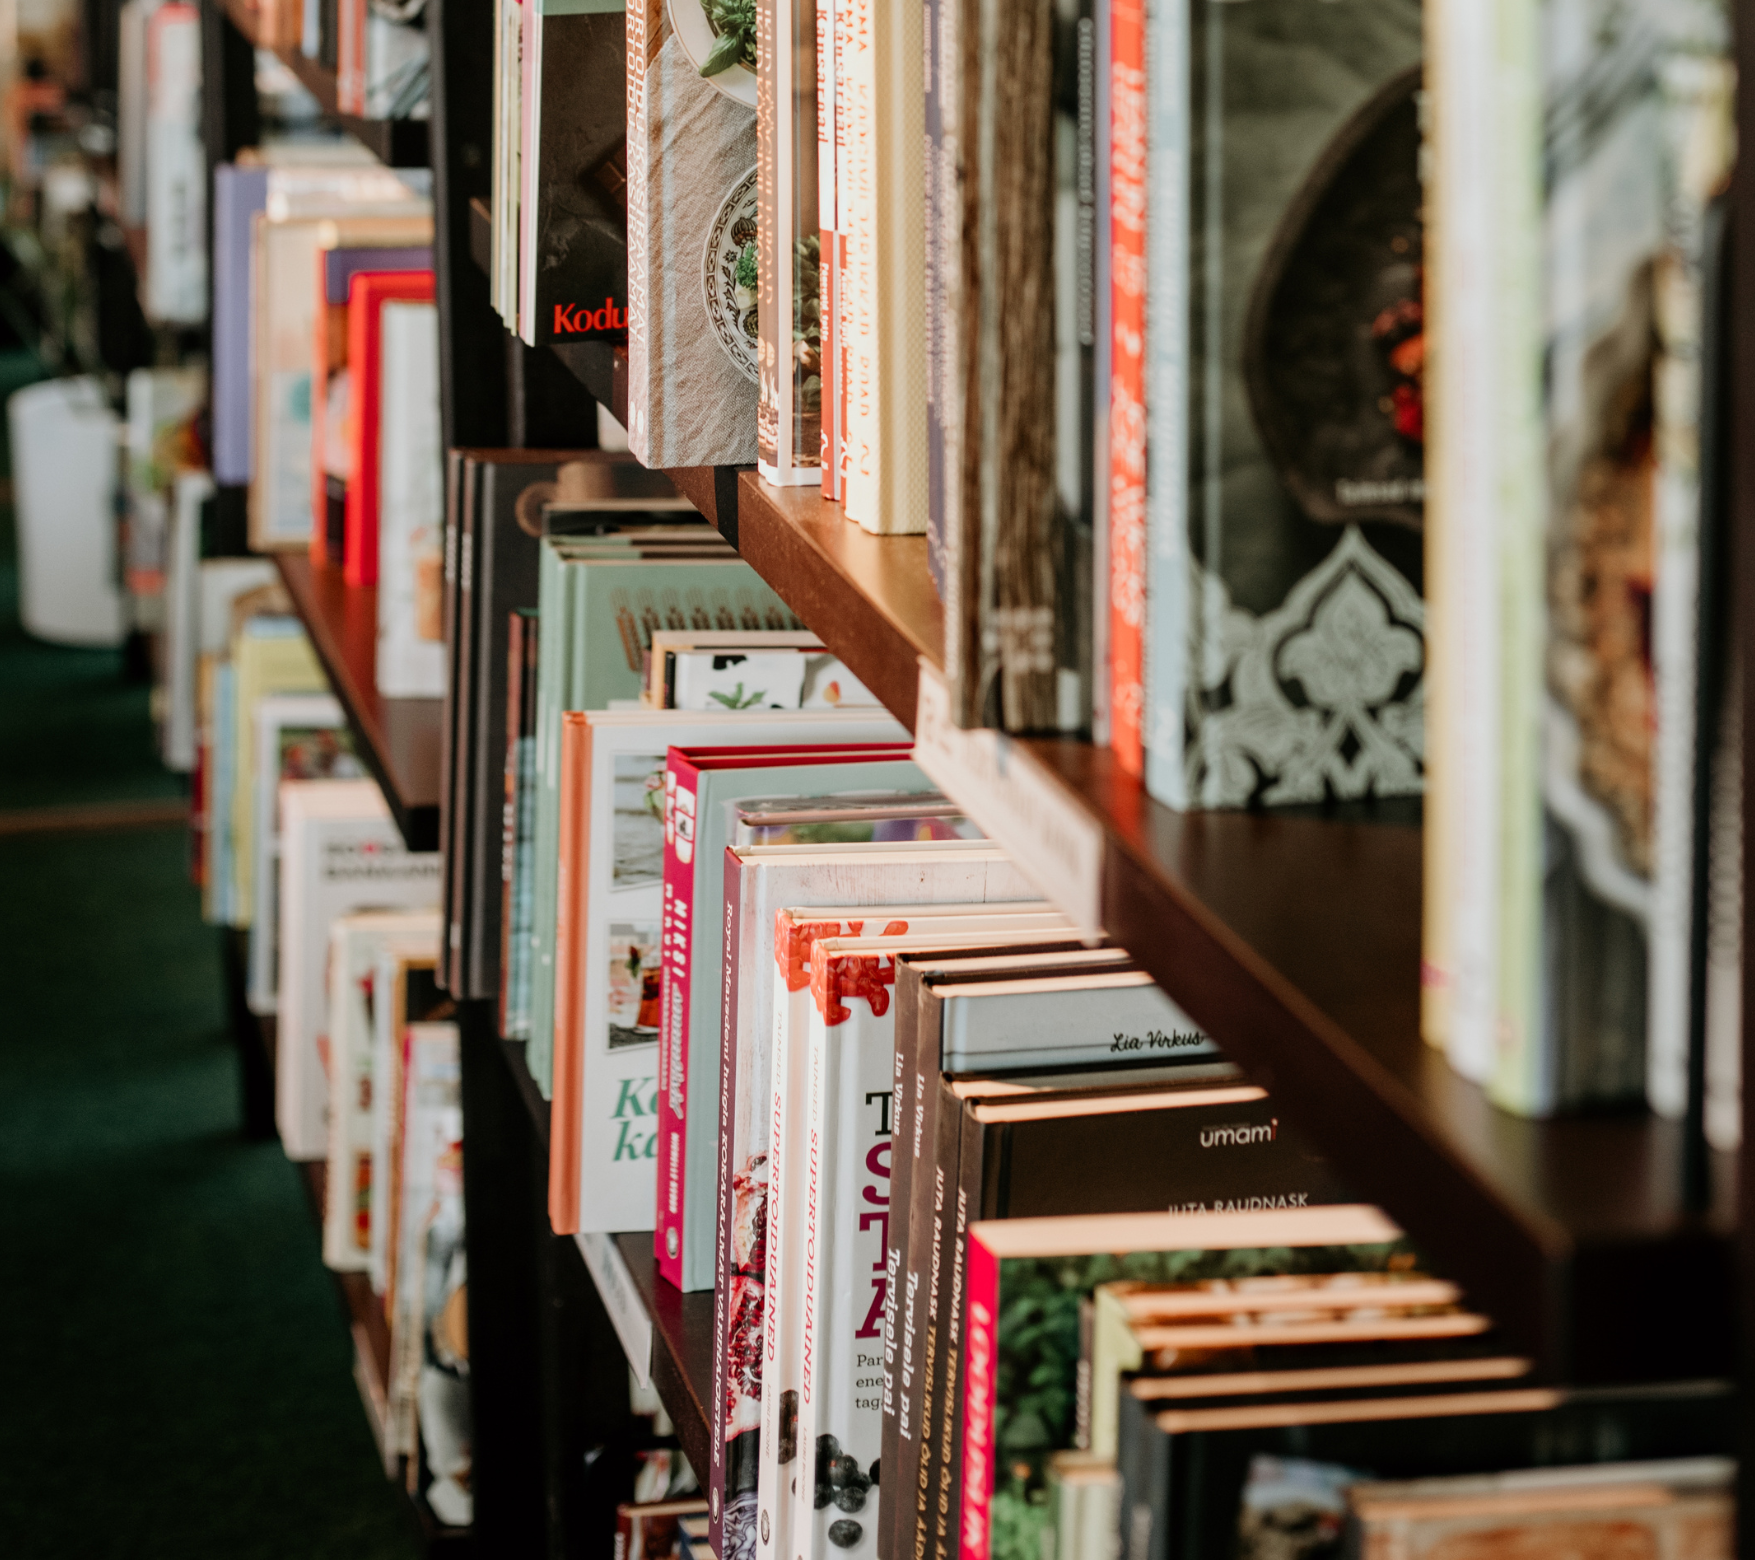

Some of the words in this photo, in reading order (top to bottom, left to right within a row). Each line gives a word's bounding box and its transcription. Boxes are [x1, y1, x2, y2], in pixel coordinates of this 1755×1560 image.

[553, 297, 629, 334] Kodu
[727, 901, 736, 960] Royal
[723, 962, 732, 1061] Marsdeni
[895, 1052, 904, 1079] Lia
[1110, 1033, 1143, 1053] Lia
[1147, 1029, 1205, 1049] Virkus
[721, 1064, 730, 1127] haigla
[894, 1082, 903, 1137] Virkus
[916, 1073, 925, 1101] Lia
[914, 1103, 924, 1159] Virkus
[1200, 1118, 1279, 1148] umami
[935, 1165, 945, 1211] JUTA
[957, 1188, 967, 1234] JUTA
[767, 1091, 782, 1362] SUPERTOIDUAINED
[803, 1128, 818, 1405] SUPERTOIDUAINED
[928, 1216, 942, 1322] RAUDNASK
[950, 1238, 964, 1345] RAUDNASK
[886, 1248, 900, 1365] Tervisele
[902, 1270, 919, 1389] Tervisele
[883, 1369, 896, 1417] pai
[921, 1325, 937, 1440] TERVISLIKUD
[941, 1348, 958, 1464] TERVISLIKUD
[900, 1391, 912, 1441] pai
[918, 1490, 927, 1512] JA
[937, 1514, 946, 1537] JA
